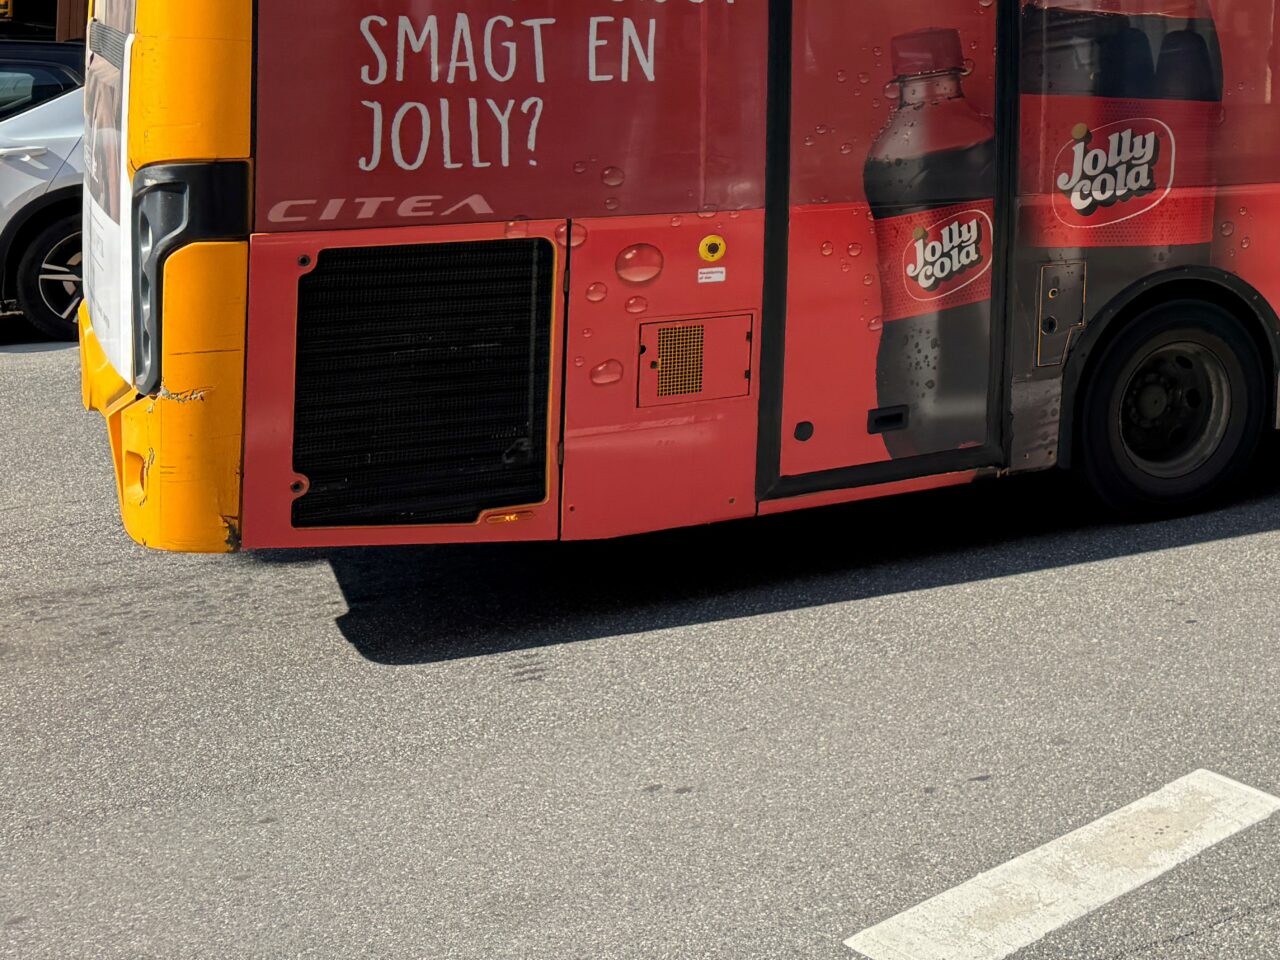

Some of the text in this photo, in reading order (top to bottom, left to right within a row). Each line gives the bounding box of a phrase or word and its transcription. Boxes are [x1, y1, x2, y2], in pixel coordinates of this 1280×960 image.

[360, 13, 656, 85] SMAGT EN
[358, 96, 543, 171] JOLLY?
[267, 193, 494, 222] CITEA
